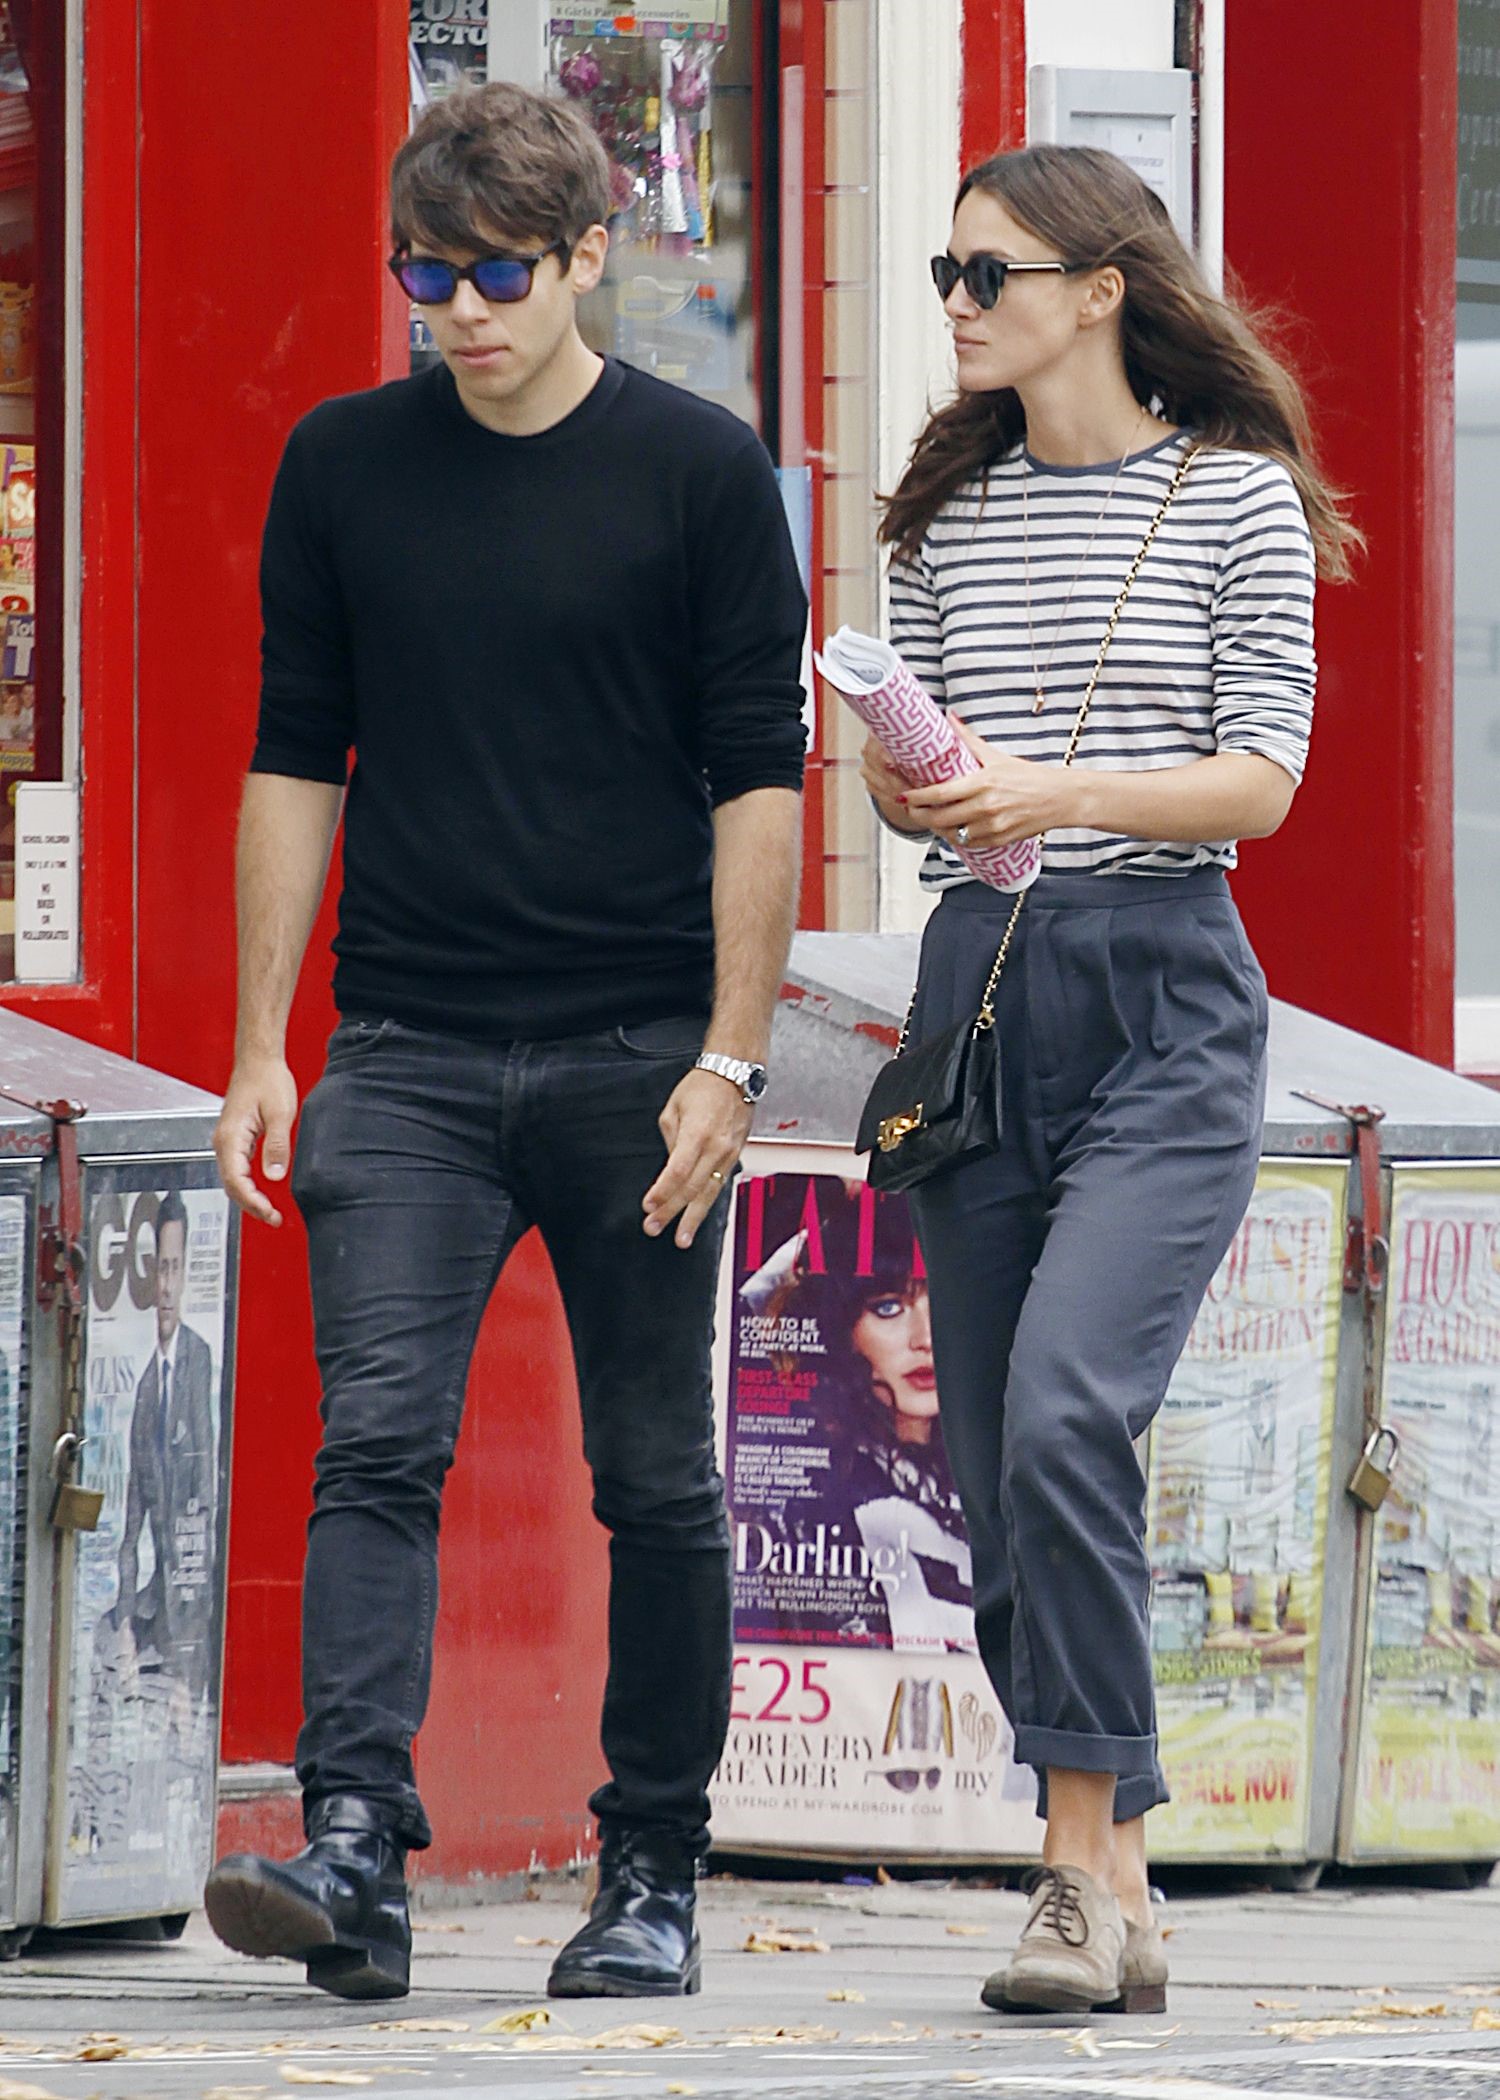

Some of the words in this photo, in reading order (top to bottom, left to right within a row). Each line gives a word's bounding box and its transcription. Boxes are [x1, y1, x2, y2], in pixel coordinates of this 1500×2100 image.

[564, 8, 592, 17] Girls
[629, 9, 690, 18] Accessories
[735, 1176, 927, 1279] TAT
[740, 1316, 777, 1330] HOW
[780, 1317, 798, 1331] TO
[802, 1318, 818, 1332] BE
[740, 1329, 820, 1344] CONFIDENT
[737, 1385, 810, 1402] DEPARTURE
[736, 1399, 790, 1415] LOUNGE
[735, 1522, 909, 1599] Darling!
[766, 1575, 825, 1590] HAPPENED
[734, 1586, 771, 1598] ESSICA
[773, 1587, 816, 1600] BROWN
[818, 1589, 868, 1602] FINDLAY
[757, 1599, 777, 1610] THE
[778, 1600, 854, 1614] BULLINGDON
[733, 1732, 773, 1758] OR
[715, 1760, 838, 1788] READER
[955, 1770, 993, 1798] my
[735, 1796, 778, 1809] SPEND
[783, 1798, 798, 1810] AT
